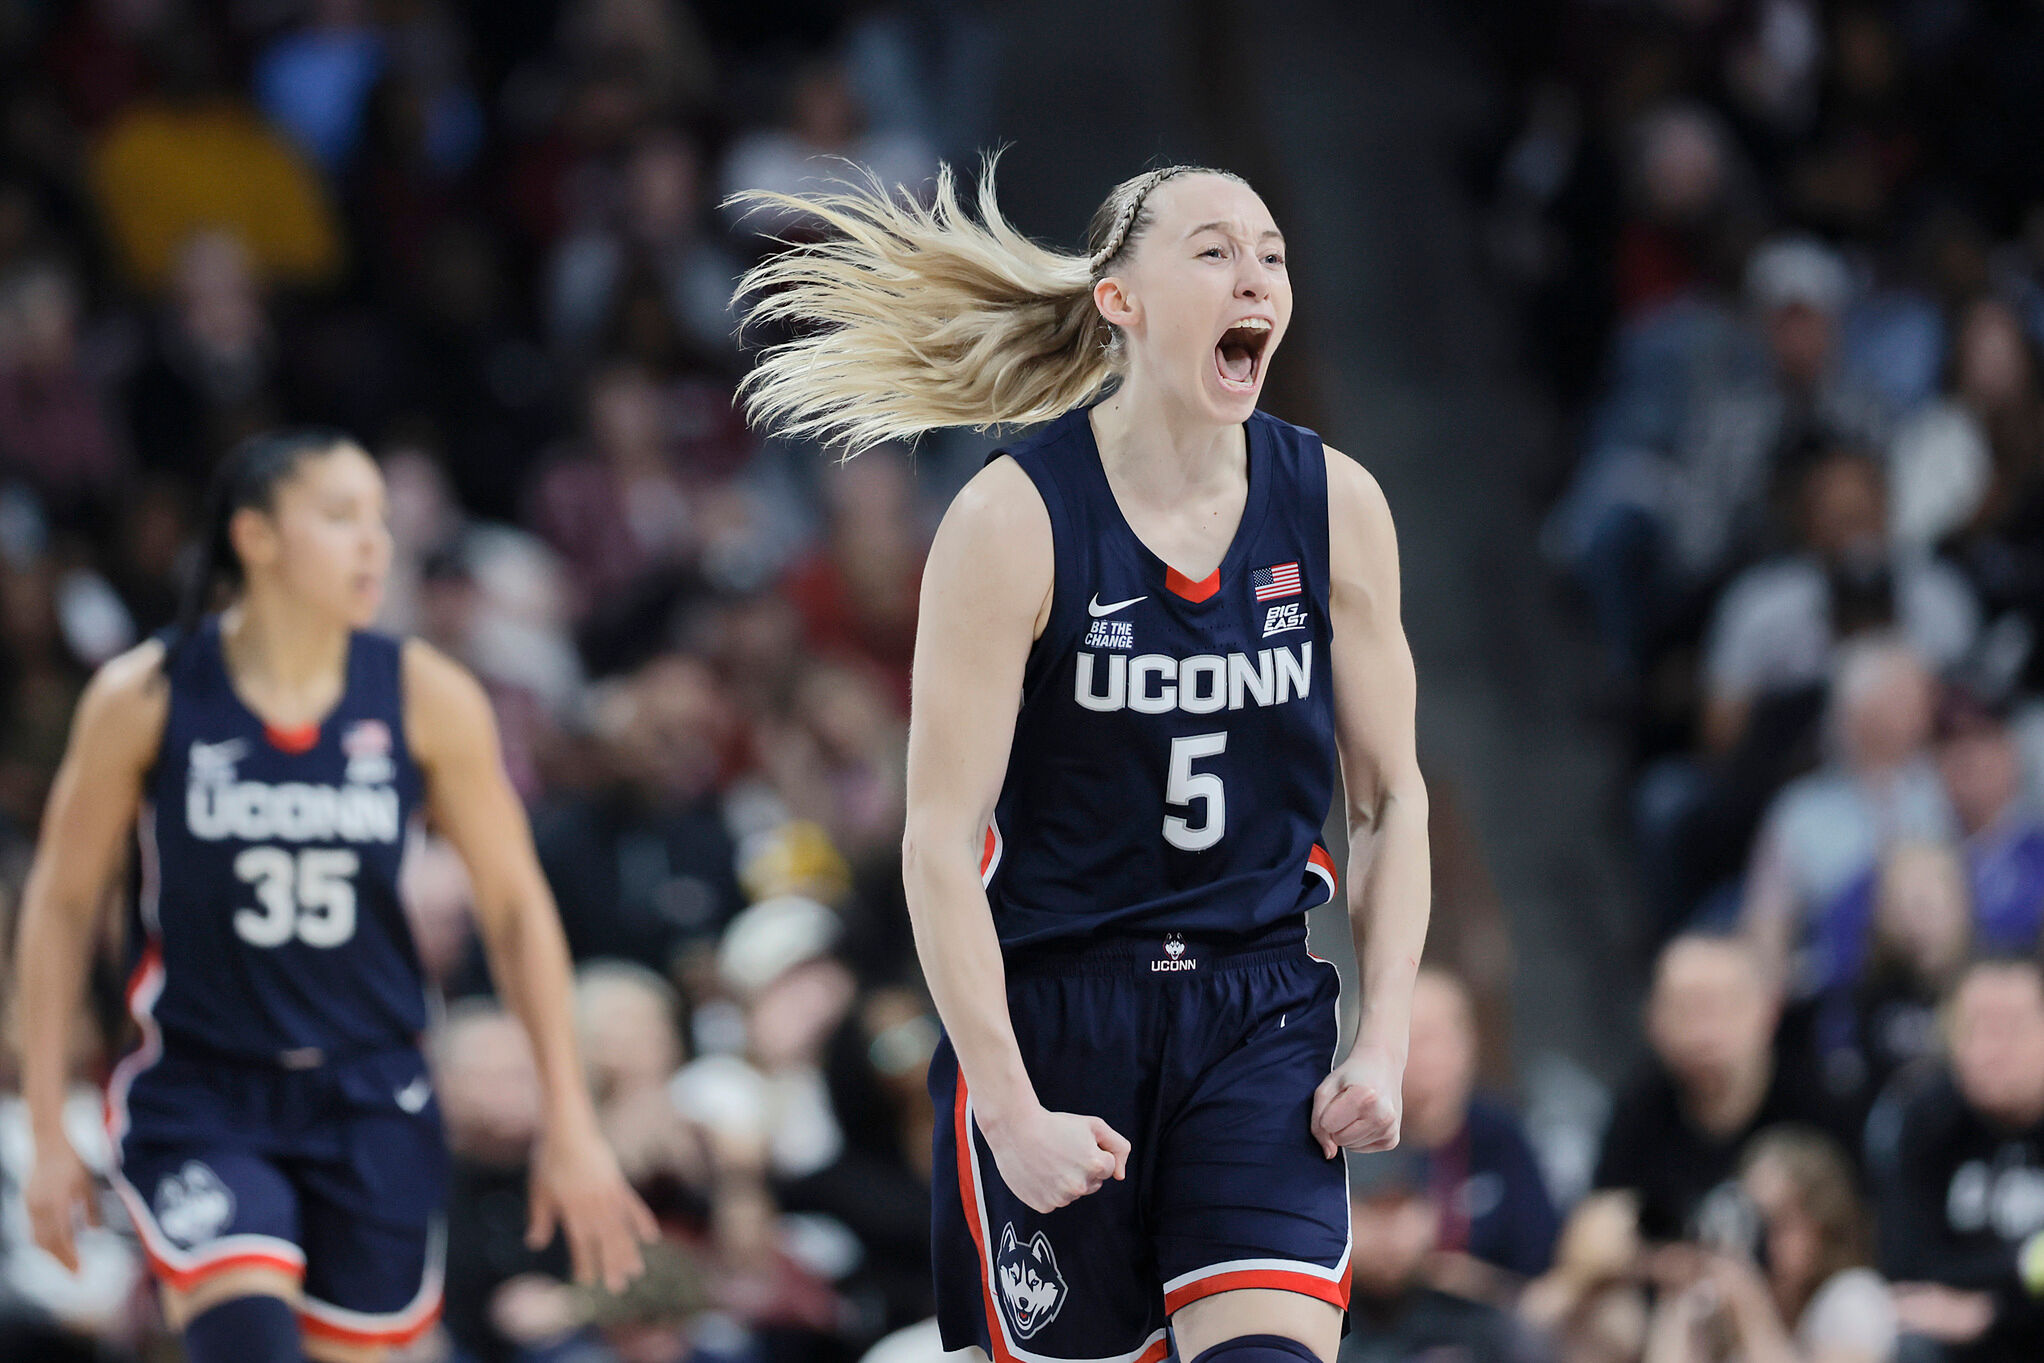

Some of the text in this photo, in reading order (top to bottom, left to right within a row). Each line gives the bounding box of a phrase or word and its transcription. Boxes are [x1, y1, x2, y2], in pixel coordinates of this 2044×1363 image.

[1267, 603, 1299, 620] BIG
[1091, 621, 1132, 636] BE THE
[1263, 613, 1308, 632] EAST
[1084, 634, 1133, 648] CHANGE
[1074, 641, 1312, 714] UCONN
[1162, 731, 1228, 851] 5
[233, 846, 360, 948] 35
[1151, 958, 1196, 972] UCONN
